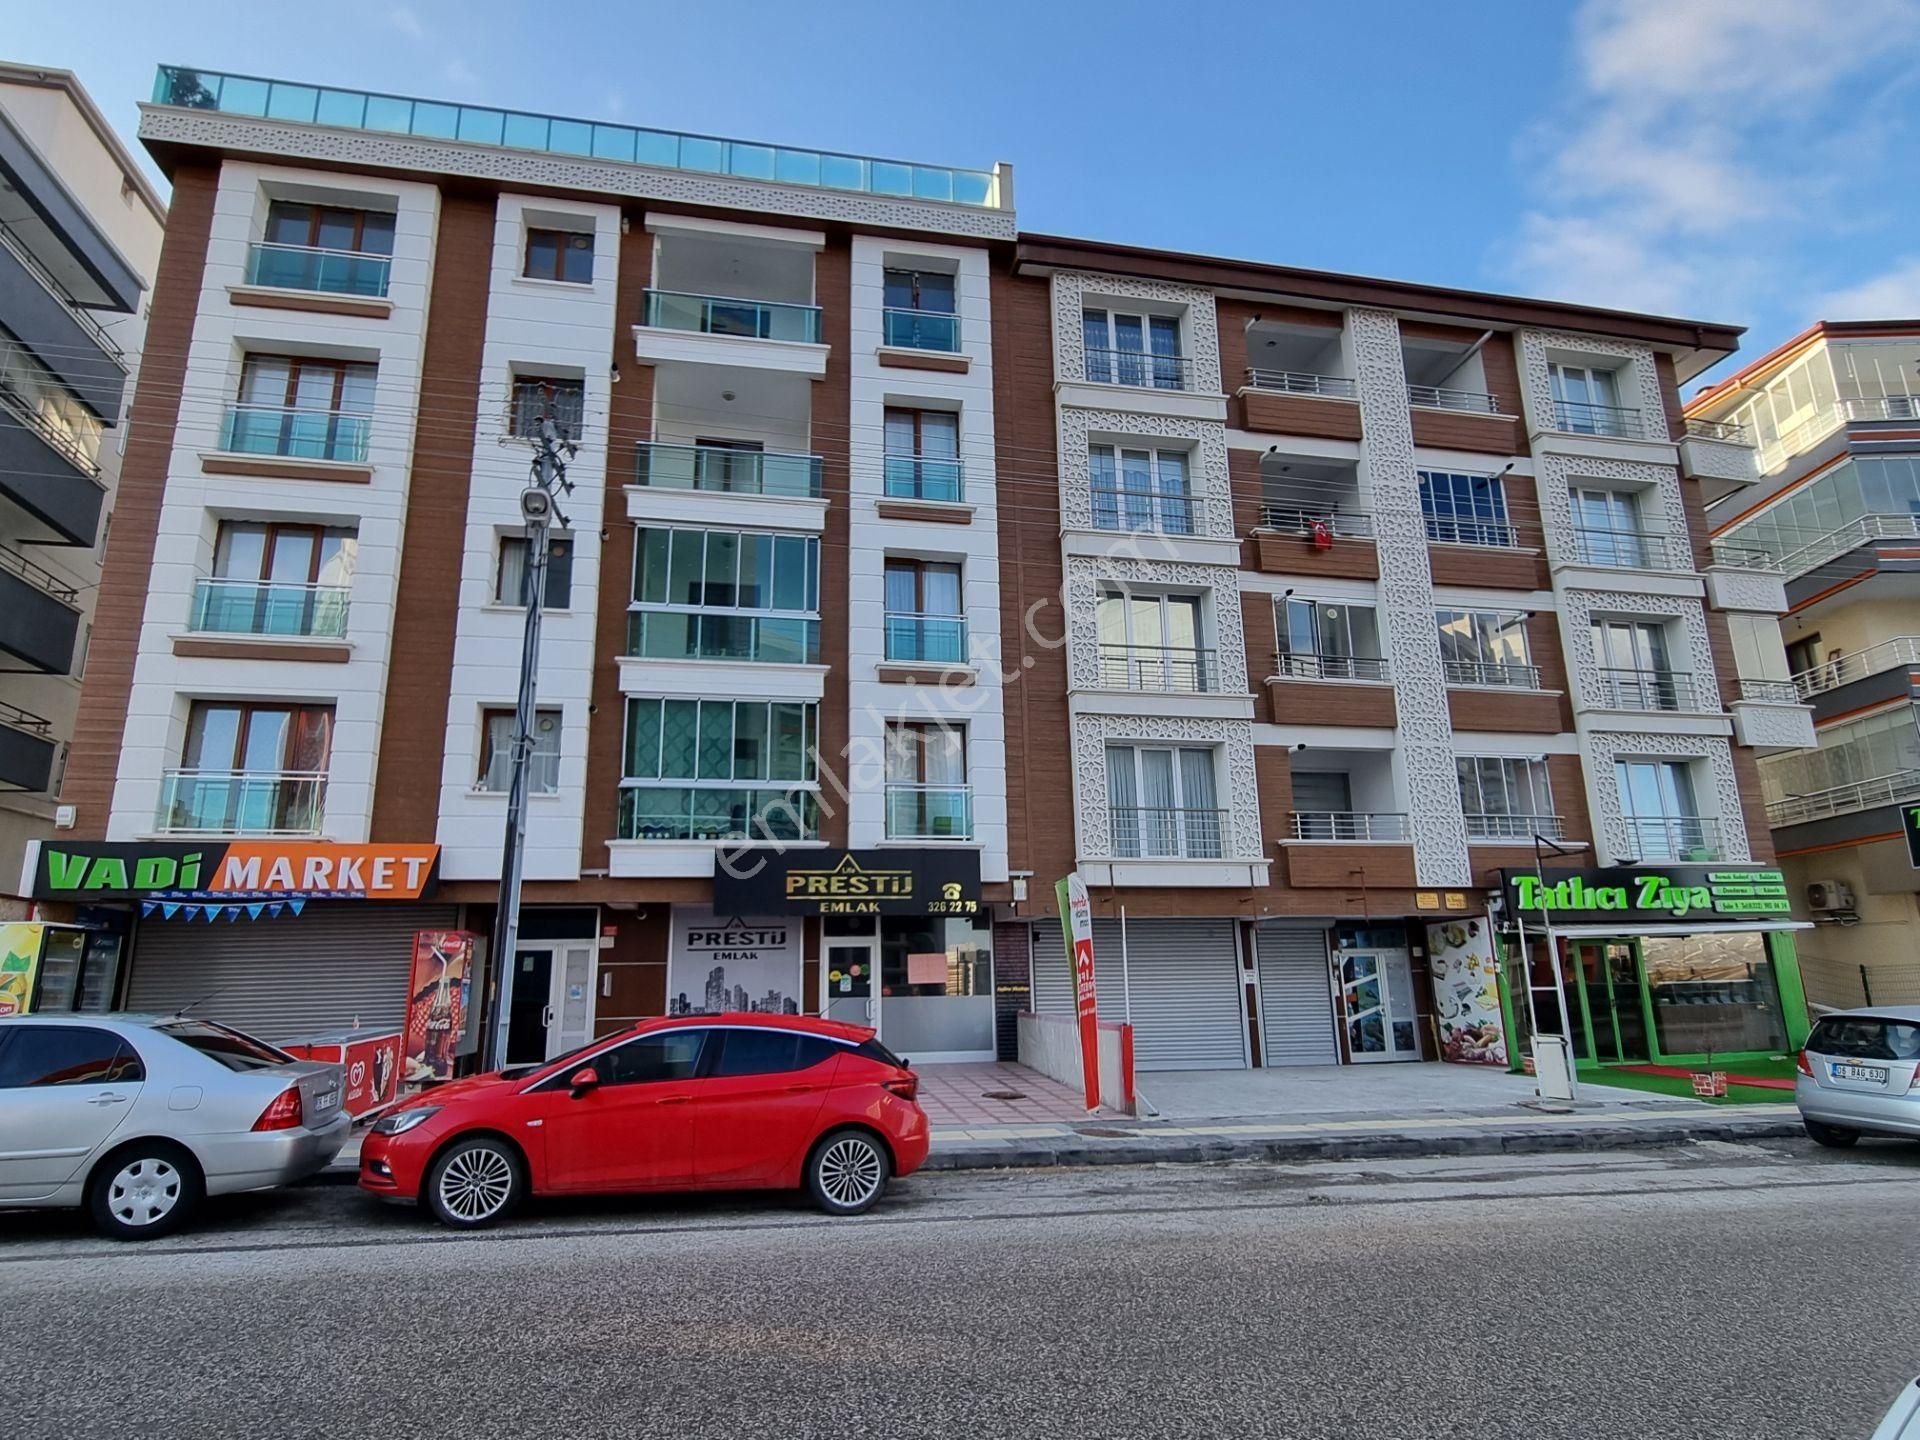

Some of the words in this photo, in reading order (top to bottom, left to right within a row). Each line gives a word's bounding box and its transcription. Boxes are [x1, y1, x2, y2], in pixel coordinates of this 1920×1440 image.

[223, 856, 429, 891] MARKET
[1511, 876, 1628, 910] Tatlıcı
[1634, 876, 1712, 916] Ziya
[820, 902, 880, 913] EMLAK
[928, 901, 946, 912] 326
[949, 901, 962, 912] 22
[713, 952, 758, 960] EMLAK
